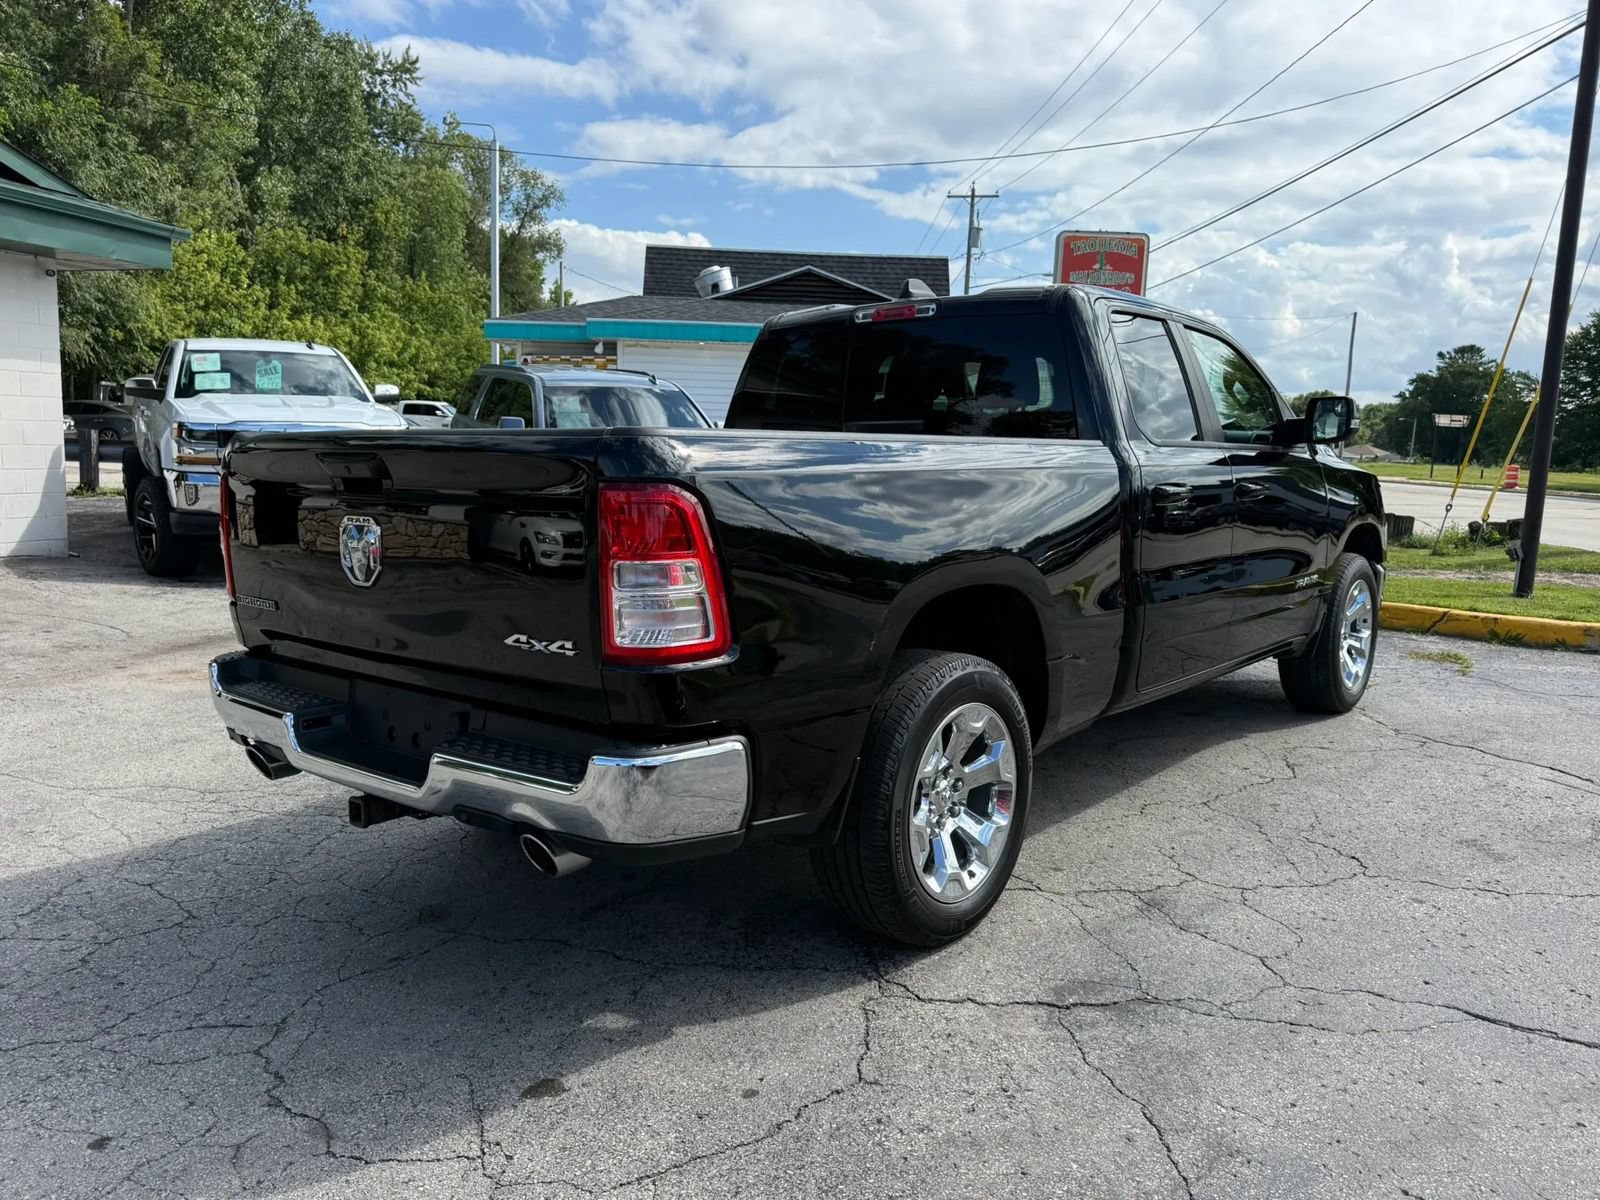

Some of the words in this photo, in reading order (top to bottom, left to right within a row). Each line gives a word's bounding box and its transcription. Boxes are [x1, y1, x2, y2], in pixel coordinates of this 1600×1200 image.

[1071, 238, 1138, 259] TAQUERIA
[257, 365, 280, 378] SALE
[236, 595, 275, 610] BIGHORN
